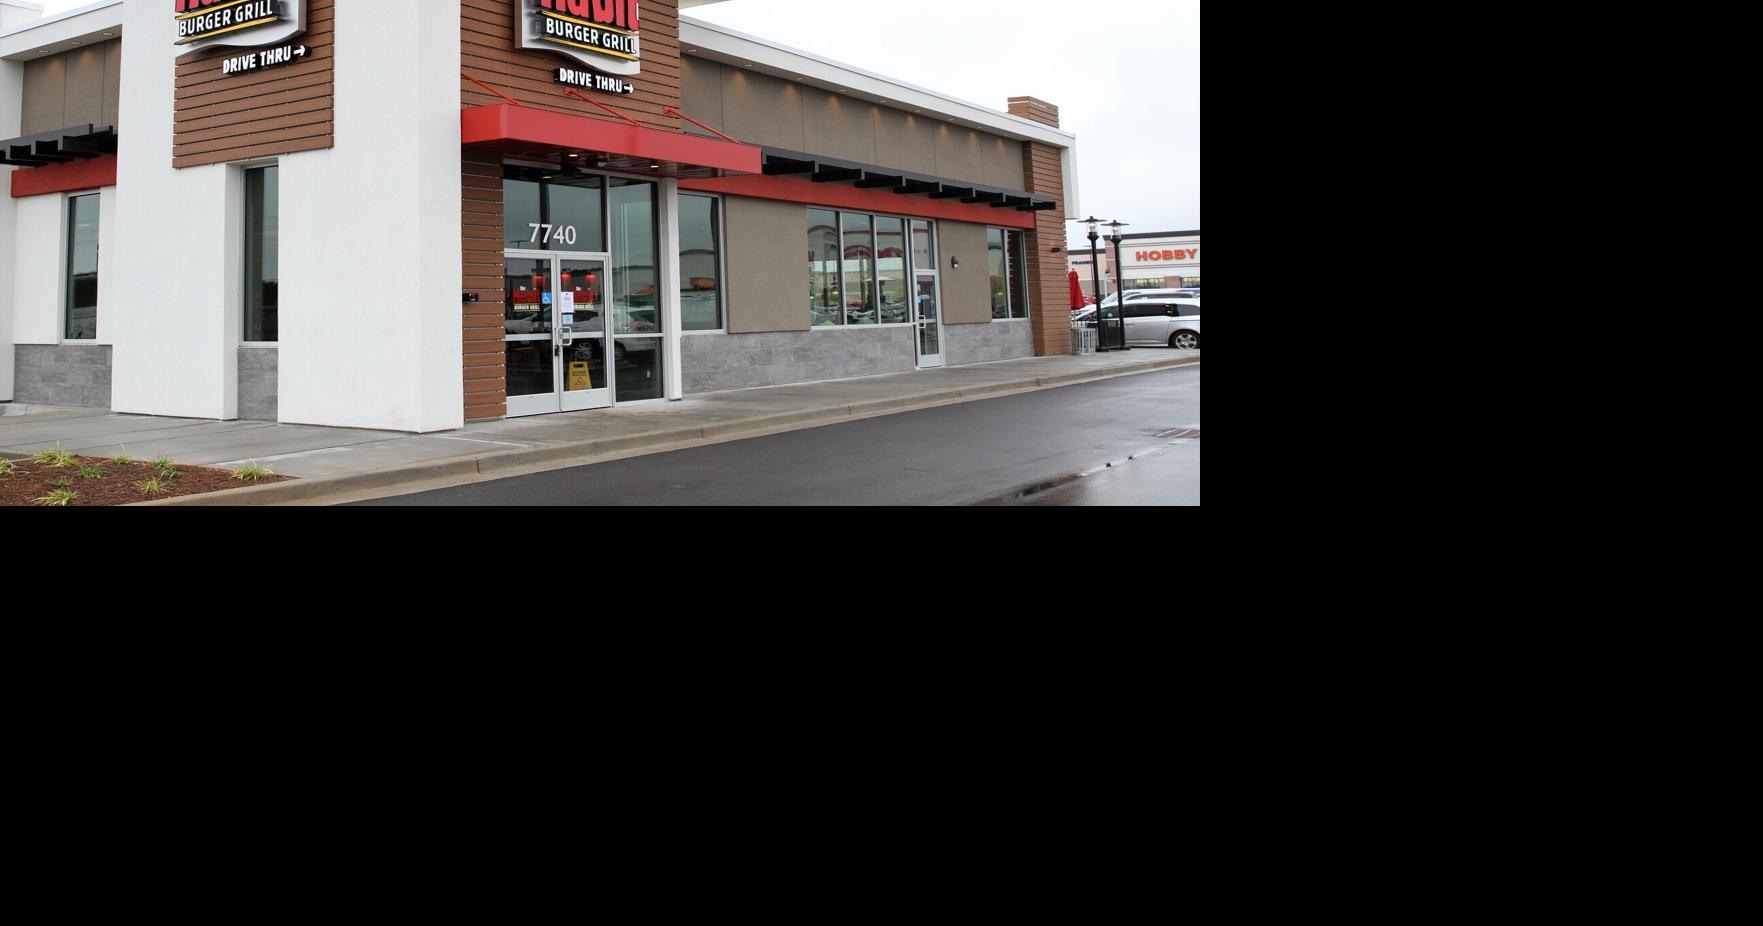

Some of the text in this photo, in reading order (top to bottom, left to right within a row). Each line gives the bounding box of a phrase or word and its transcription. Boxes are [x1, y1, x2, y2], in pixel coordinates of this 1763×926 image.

[178, 9, 231, 37] BURGER
[235, 0, 273, 22] GRILL
[540, 0, 640, 32] abit
[546, 17, 637, 54] BURGER GRILL
[222, 45, 292, 74] DRIVE THRU
[559, 67, 623, 93] DRIVE THRU
[528, 222, 577, 245] 7740
[1135, 248, 1198, 262] HOBBY
